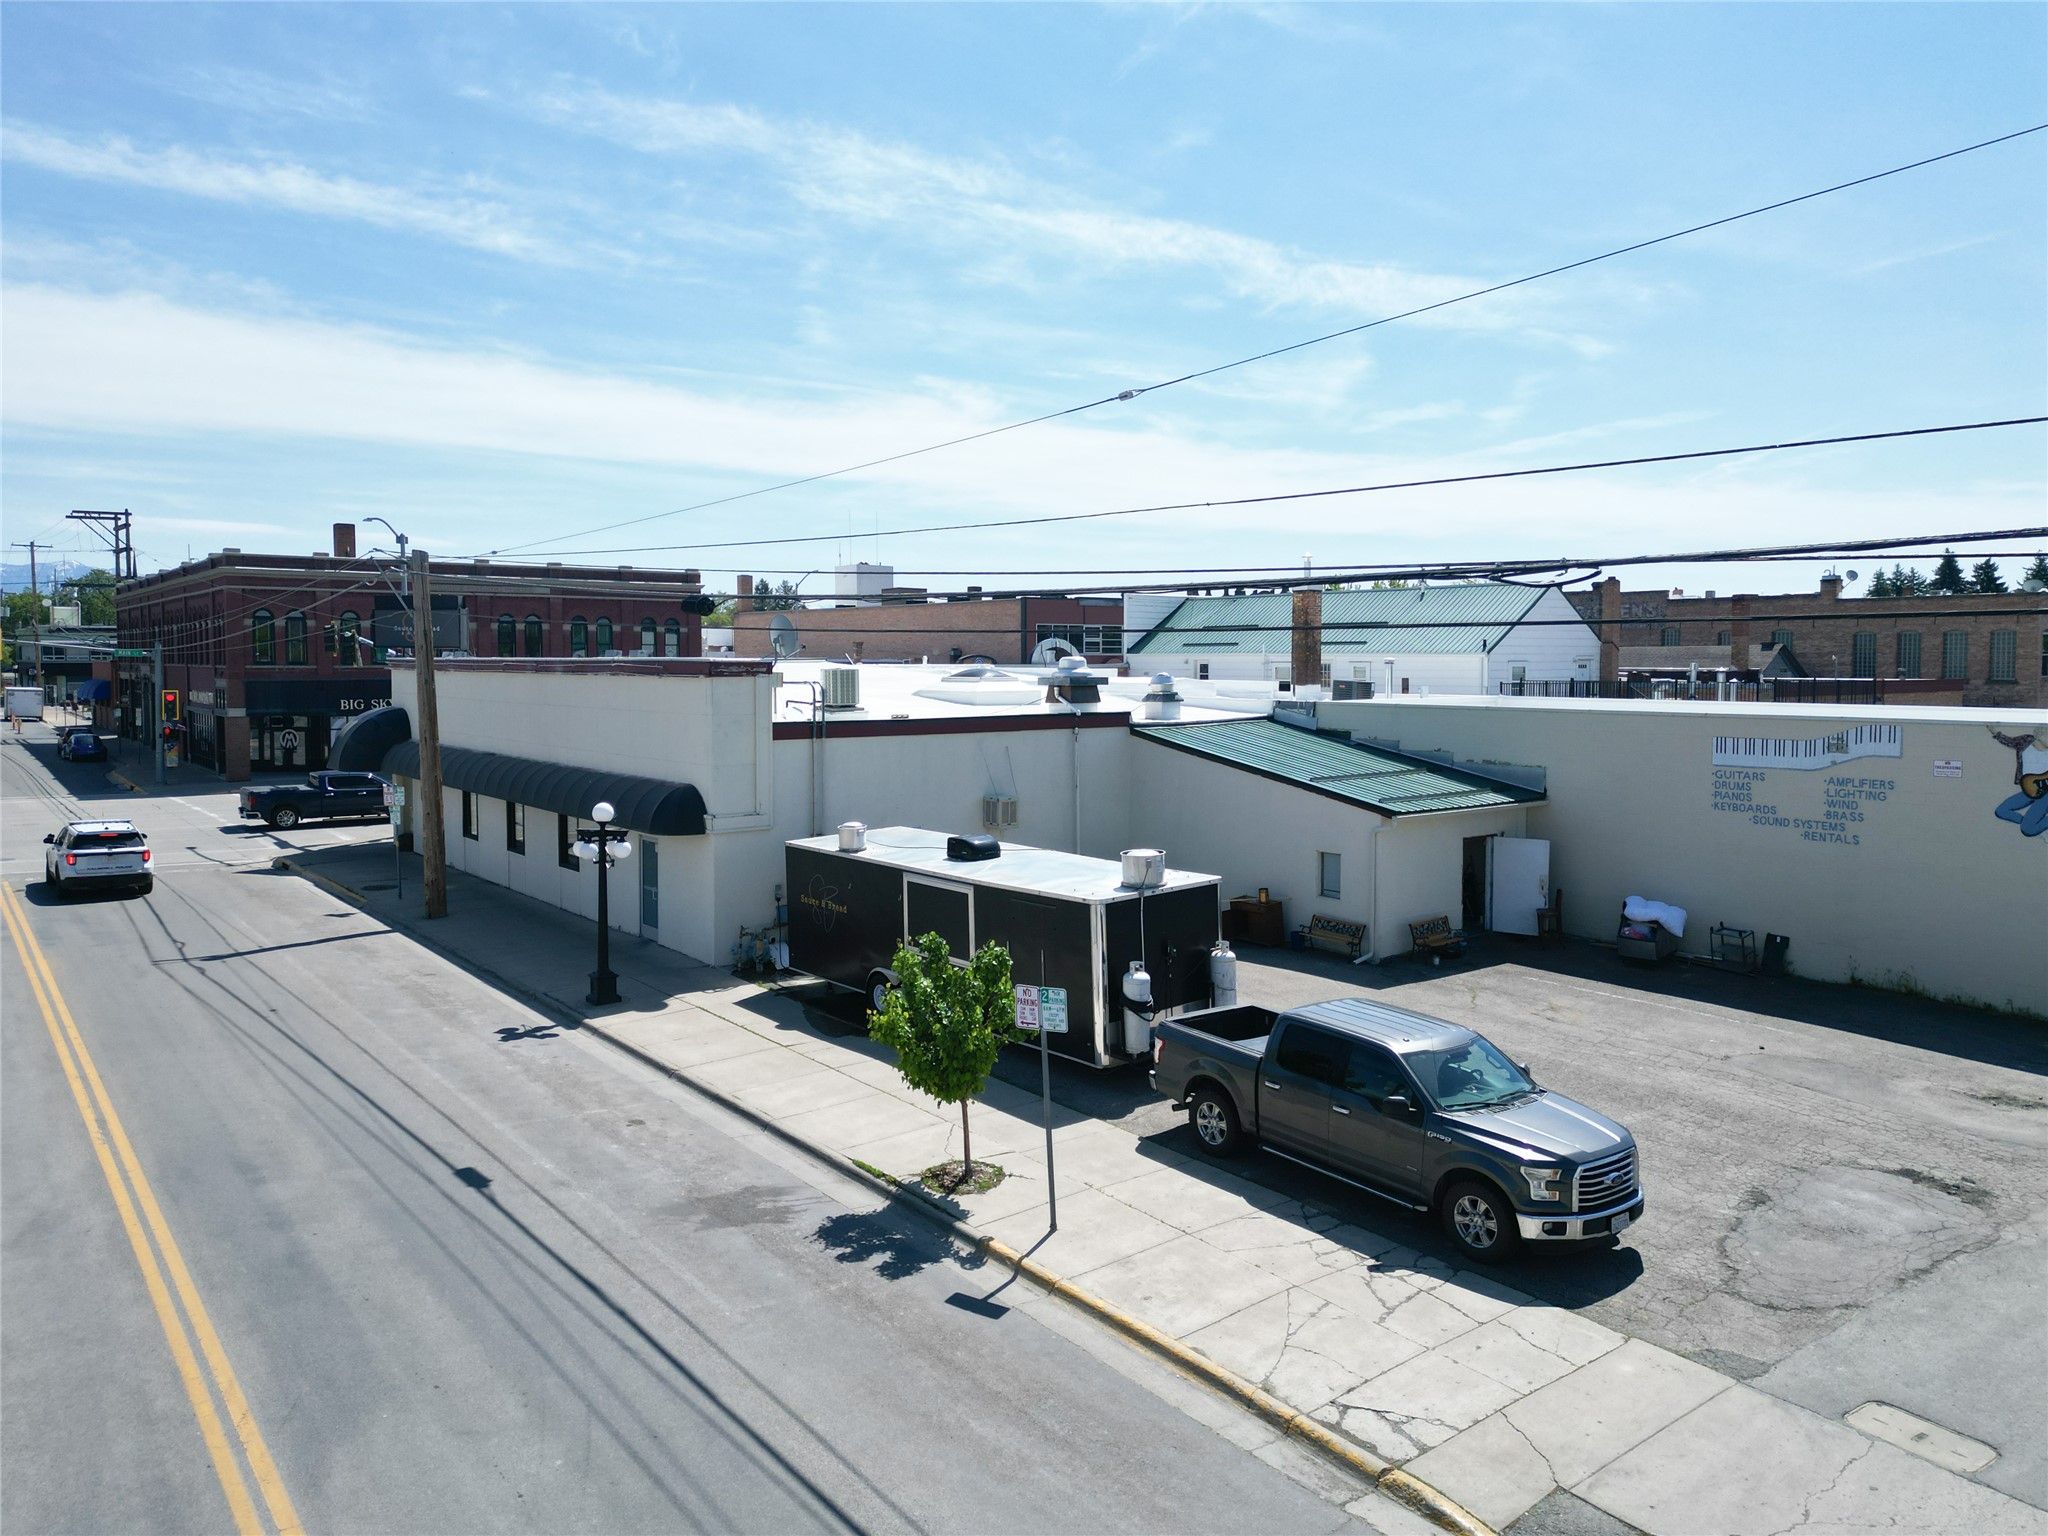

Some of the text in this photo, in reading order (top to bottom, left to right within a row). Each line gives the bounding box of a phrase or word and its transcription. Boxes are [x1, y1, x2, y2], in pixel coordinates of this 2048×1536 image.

[340, 699, 365, 710] BIG
[1714, 770, 1766, 782] GUITARS
[1714, 781, 1752, 792] DRUMS
[1826, 777, 1895, 790] AMPLIFIERS
[1714, 791, 1752, 801] PIANOS
[1826, 788, 1887, 801] LIGHTING
[1713, 802, 1777, 815] KEYBOARDS
[1826, 800, 1859, 810] WIND
[1825, 812, 1864, 822] BRASS
[1752, 815, 1846, 832] SOUND SYSTEMS
[1803, 832, 1860, 845] RENTALS
[800, 894, 820, 906] Sauce
[827, 900, 847, 914] Bread
[1022, 988, 1032, 997] NO
[1041, 990, 1048, 1002] 2
[1017, 997, 1038, 1007] PARKING
